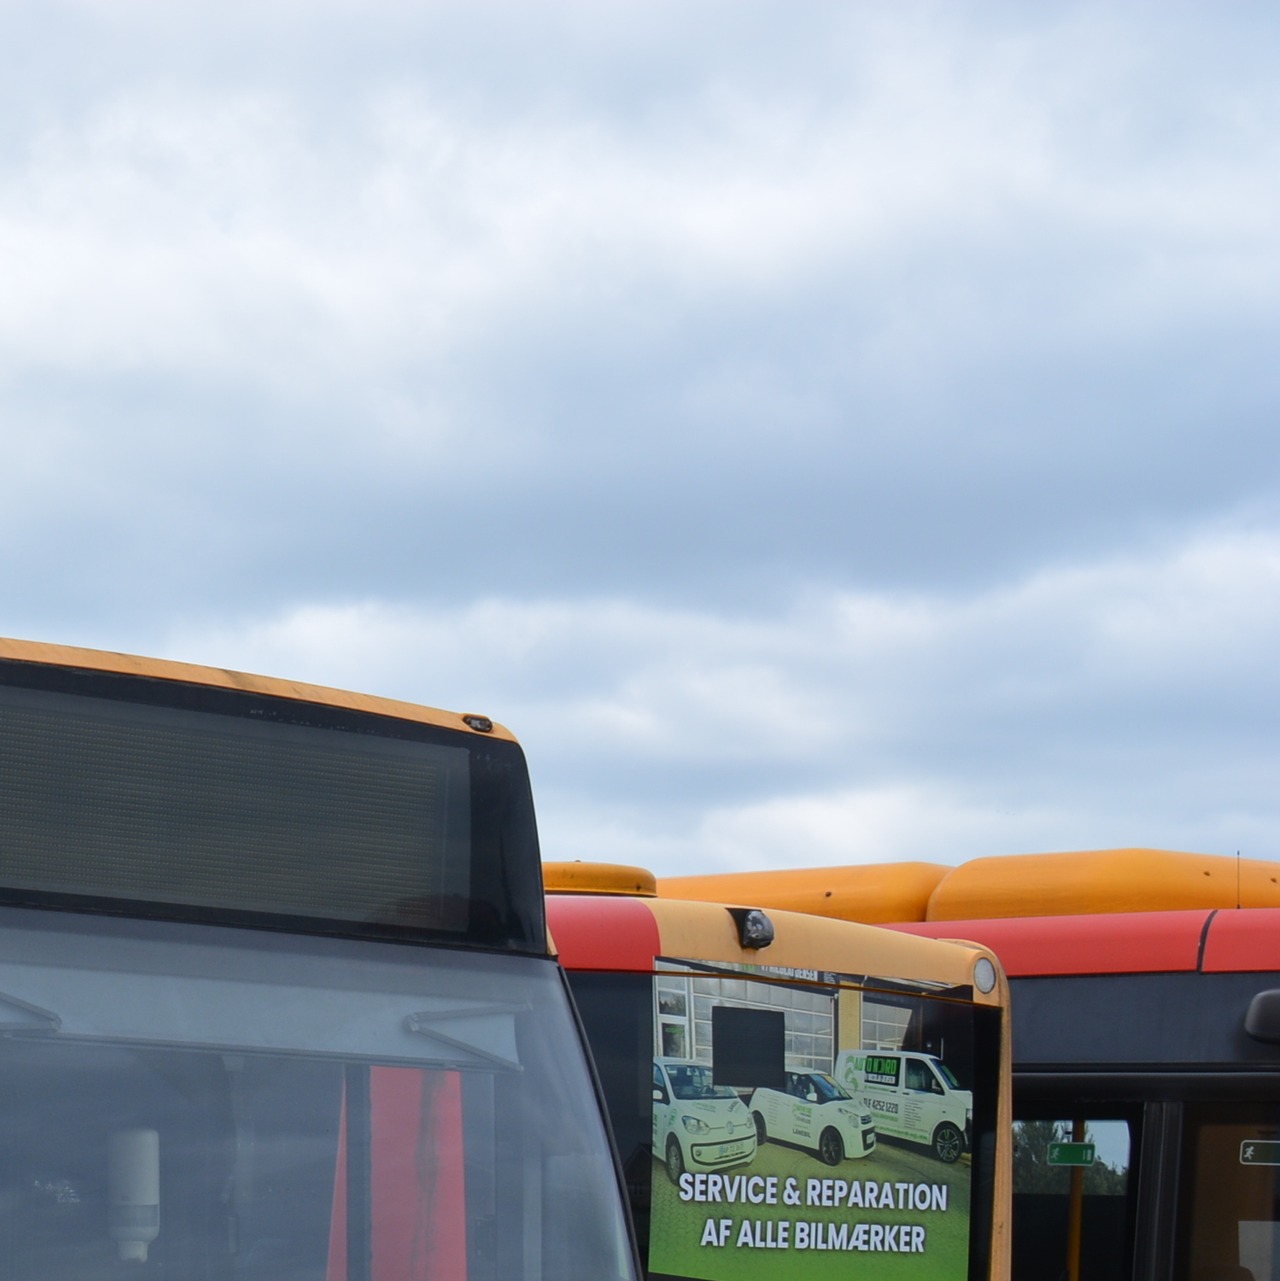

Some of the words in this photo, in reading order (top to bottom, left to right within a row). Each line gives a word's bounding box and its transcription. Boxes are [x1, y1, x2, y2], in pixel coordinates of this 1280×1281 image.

[679, 1173, 778, 1204] SERVICE
[783, 1177, 801, 1205] &
[806, 1178, 948, 1212] REPARATION
[700, 1218, 733, 1247] AF
[736, 1219, 790, 1249] ALLE
[794, 1221, 926, 1252] BILMÆRKER
